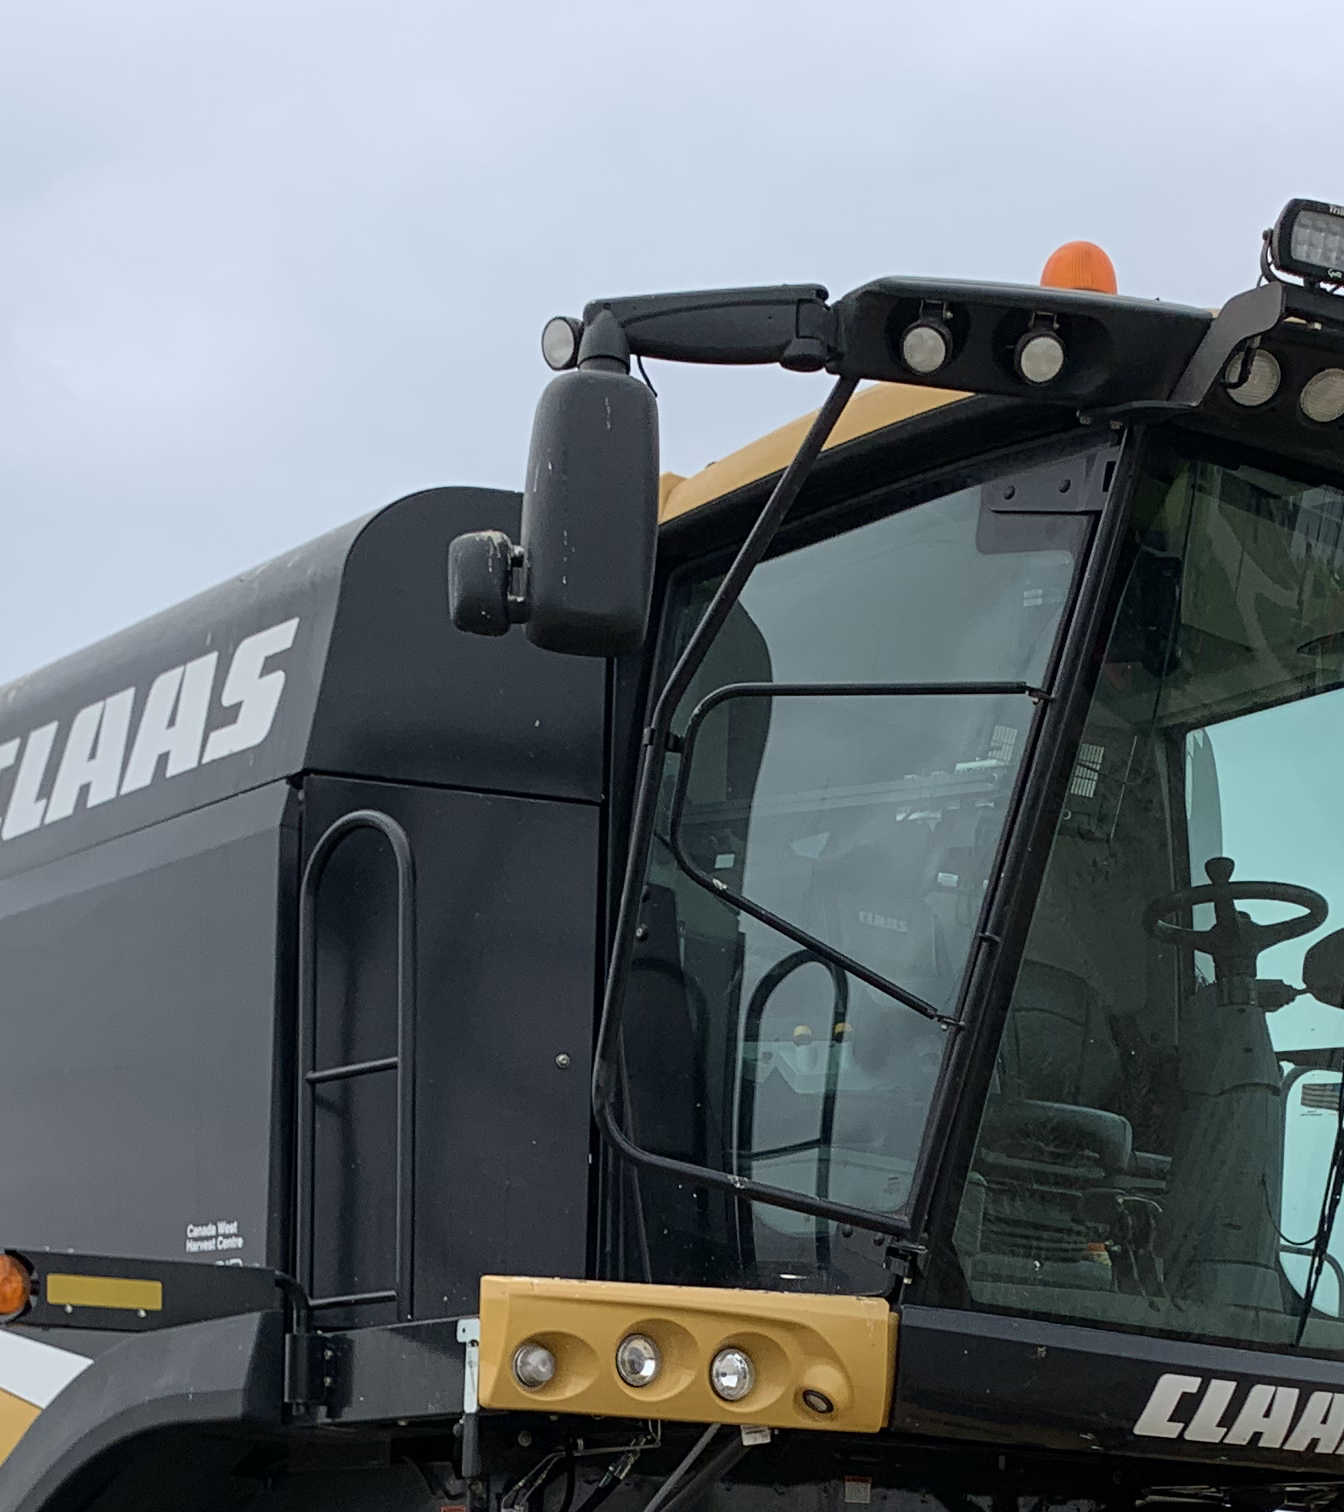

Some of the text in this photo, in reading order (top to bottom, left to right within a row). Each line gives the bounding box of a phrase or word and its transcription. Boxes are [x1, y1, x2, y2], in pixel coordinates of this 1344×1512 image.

[186, 1220, 238, 1238] Canada West
[185, 1237, 216, 1253] Harvest
